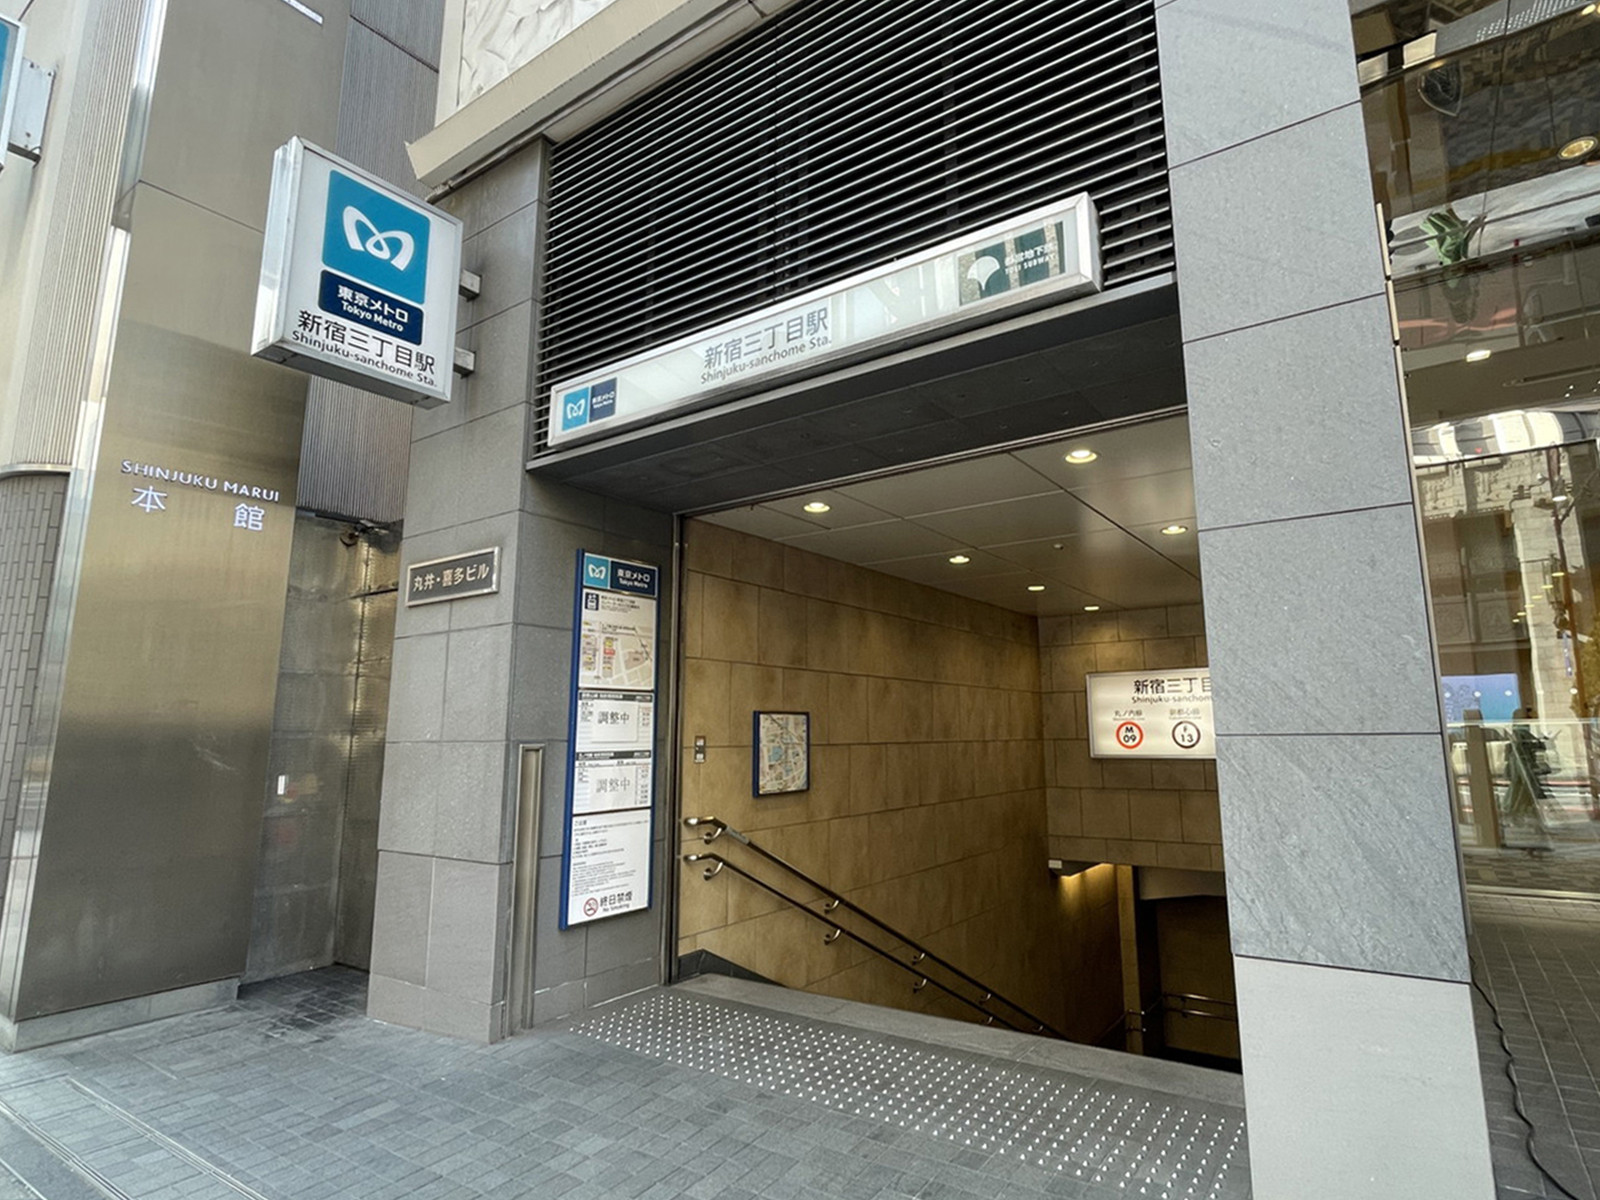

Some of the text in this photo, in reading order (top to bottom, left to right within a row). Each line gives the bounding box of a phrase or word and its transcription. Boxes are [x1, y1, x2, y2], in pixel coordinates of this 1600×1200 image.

[337, 285, 408, 323] 東京メトロ
[341, 301, 404, 332] Tokyo Metro
[292, 329, 437, 388] Shinjuku-sanchome Sta.
[298, 309, 435, 375] 新宿三丁目駅
[704, 307, 828, 369] 新宿三丁目駅
[701, 336, 831, 384] Shinjuku-sanchome Sta.
[122, 460, 280, 502] SHINJUKU MARUI
[1123, 735, 1136, 743] 09
[1181, 734, 1193, 742] 13
